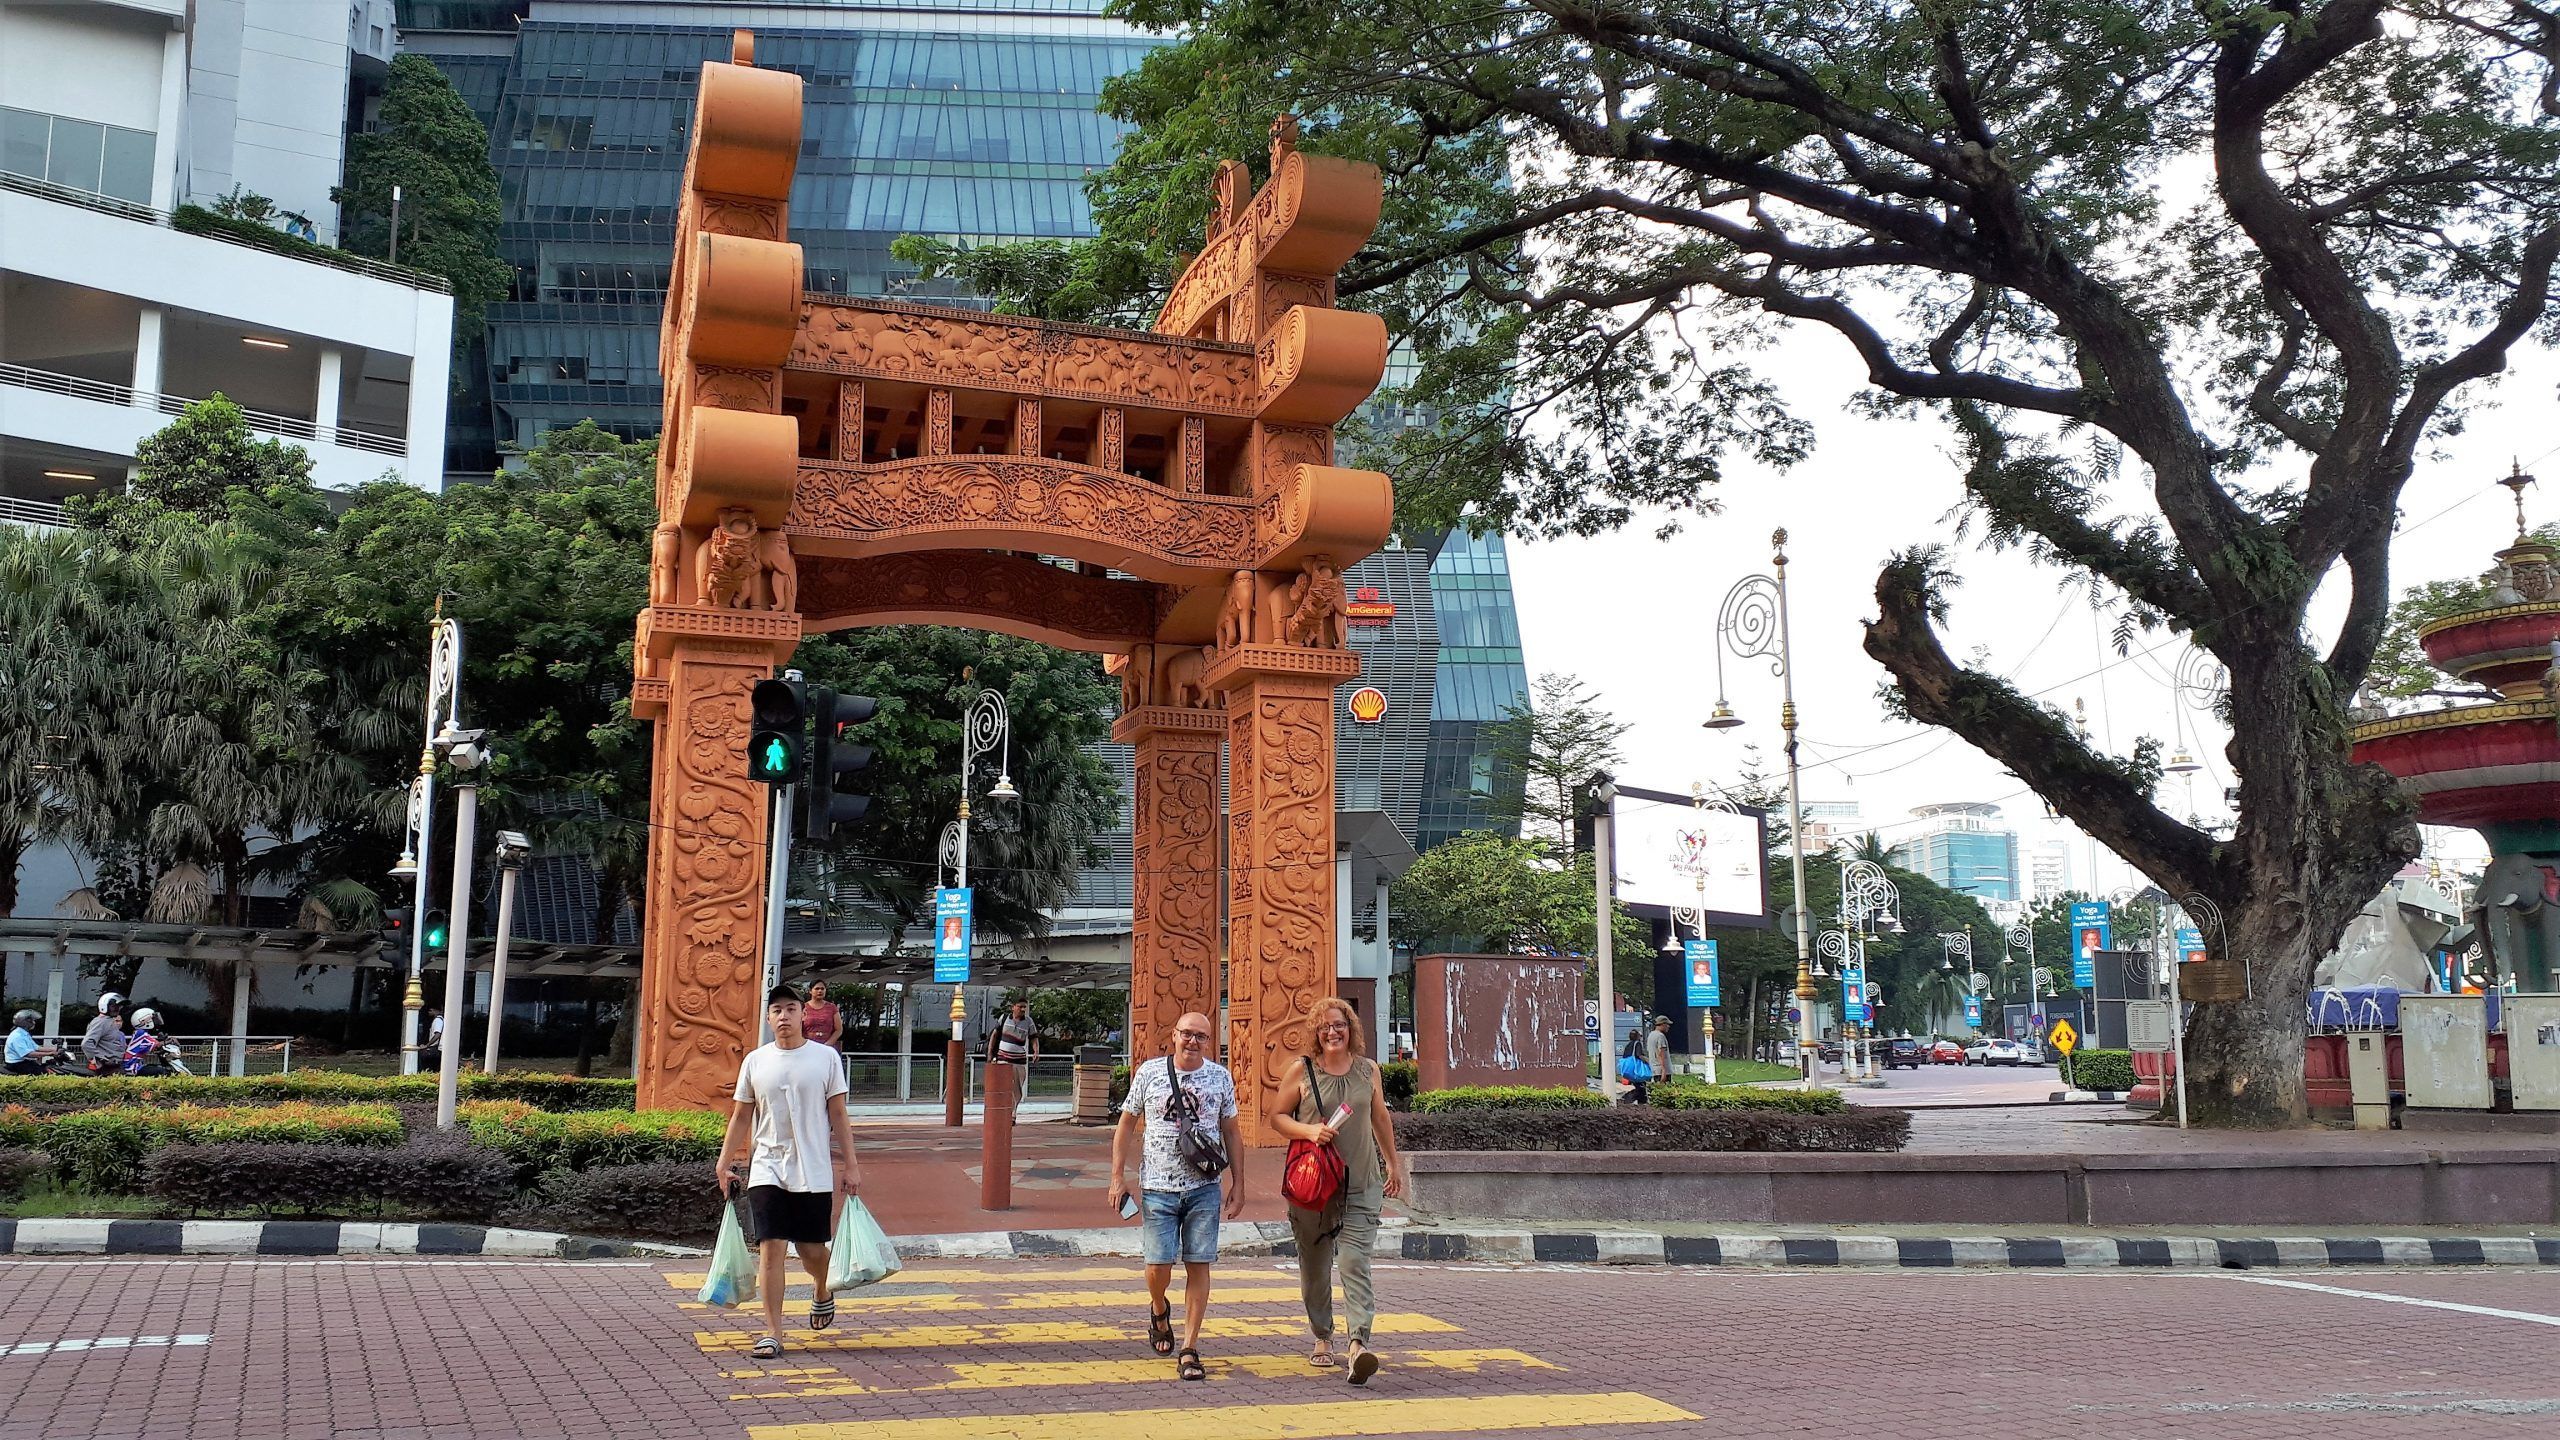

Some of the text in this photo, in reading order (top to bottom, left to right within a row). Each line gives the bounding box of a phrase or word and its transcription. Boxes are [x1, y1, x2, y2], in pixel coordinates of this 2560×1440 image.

[1346, 605, 1392, 614] AmGeneral
[945, 893, 961, 903] Yoga
[2080, 906, 2098, 916] Yoga
[1692, 943, 1708, 951] Yoga
